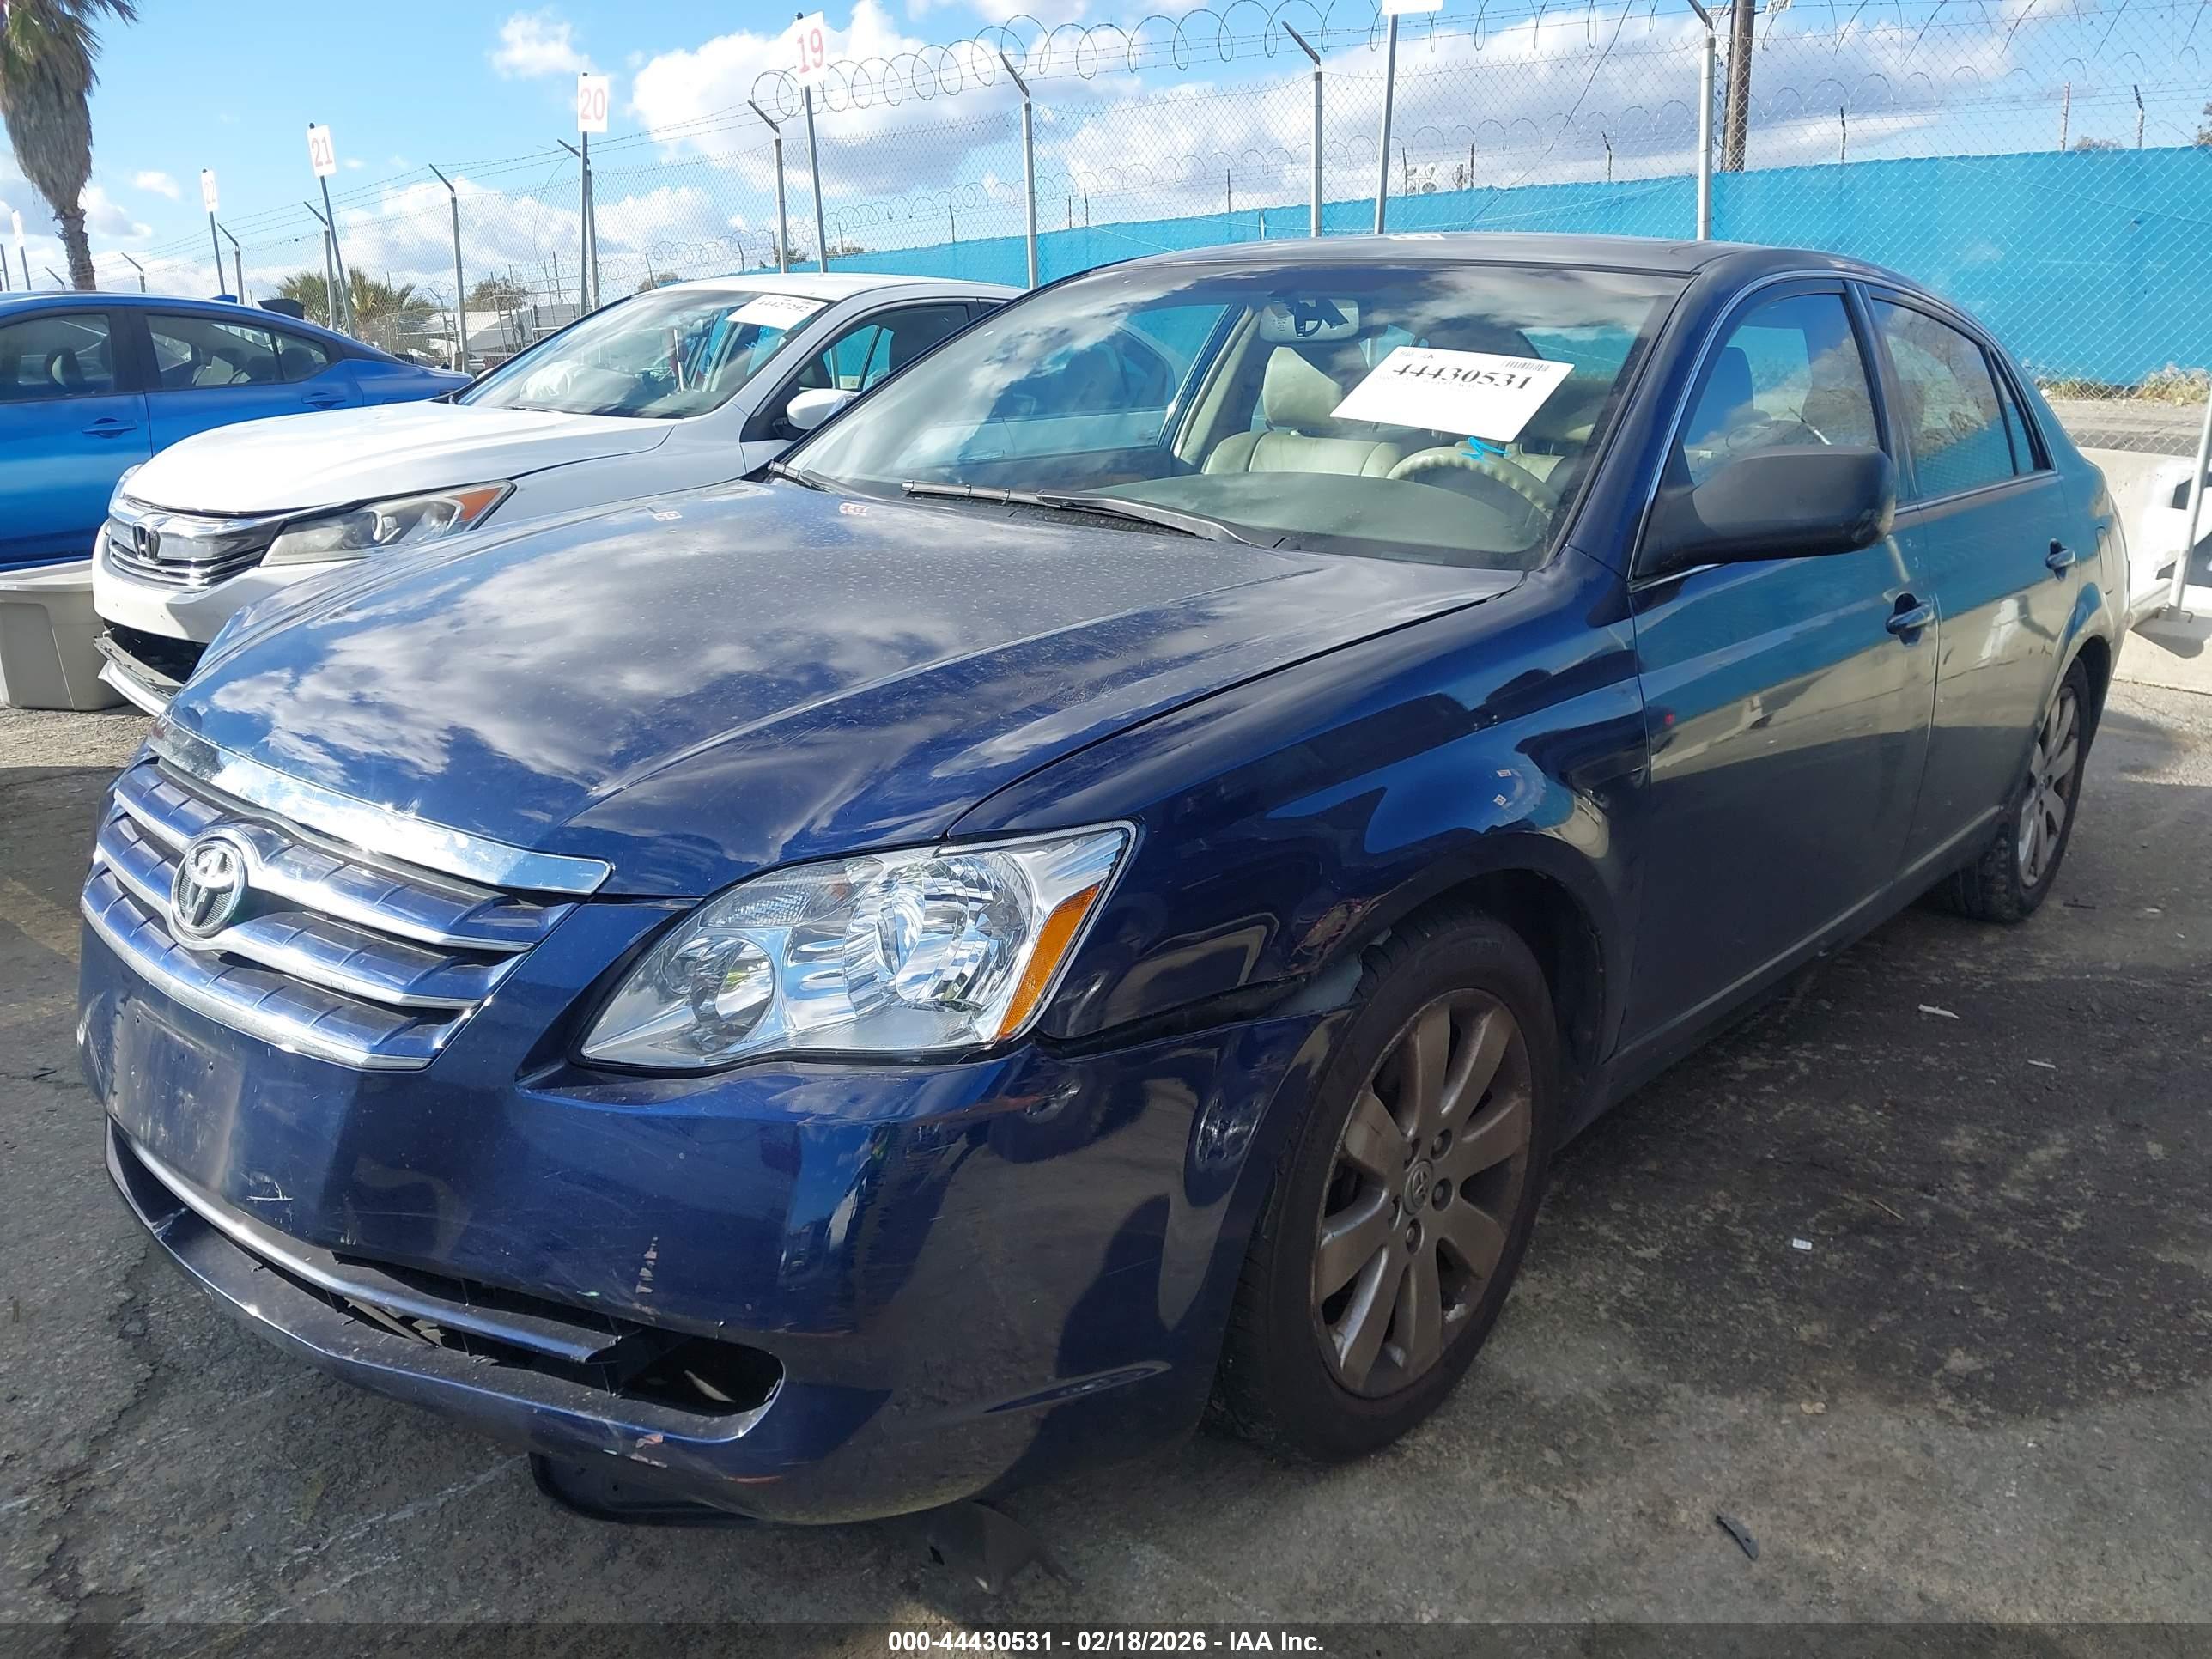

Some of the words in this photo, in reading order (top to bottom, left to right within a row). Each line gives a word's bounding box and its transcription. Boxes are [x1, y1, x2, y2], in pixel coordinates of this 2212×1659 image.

[796, 27, 823, 74] 19
[580, 87, 605, 121] 20
[311, 137, 333, 167] 21
[1392, 362, 1533, 390] 44430531
